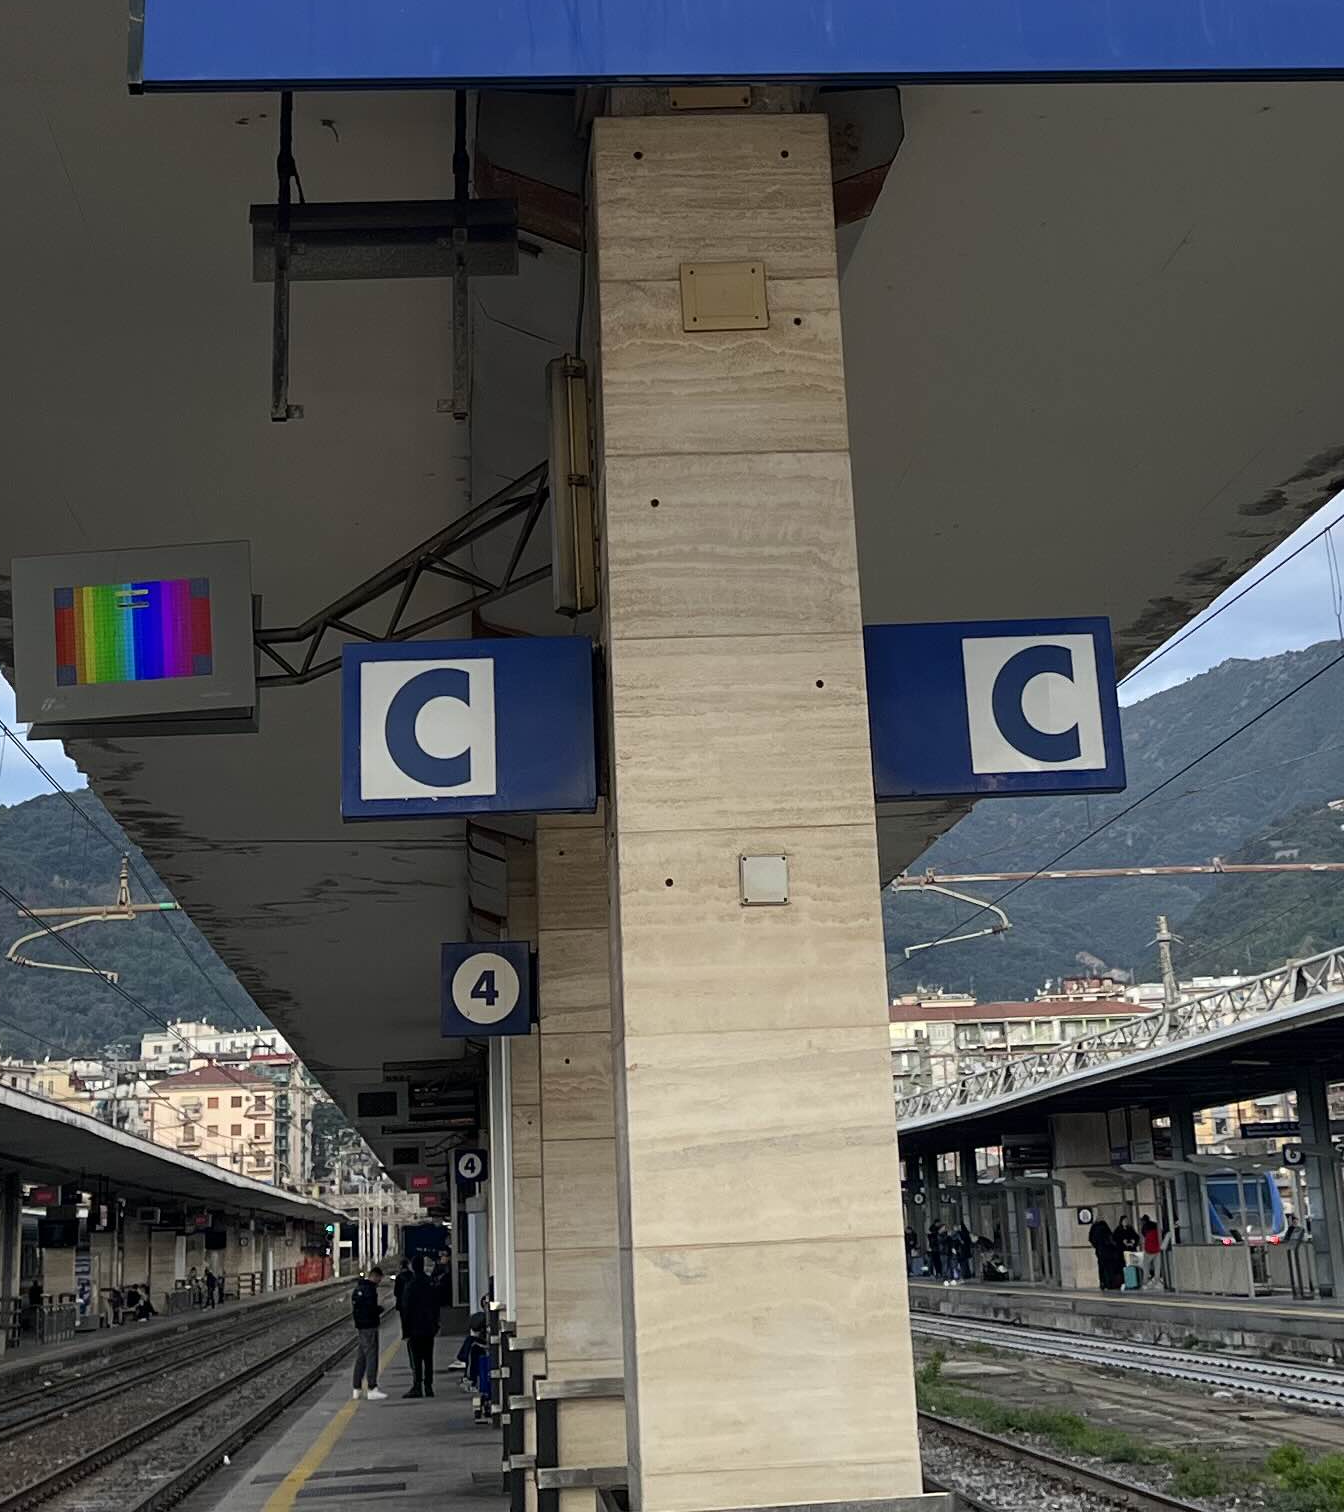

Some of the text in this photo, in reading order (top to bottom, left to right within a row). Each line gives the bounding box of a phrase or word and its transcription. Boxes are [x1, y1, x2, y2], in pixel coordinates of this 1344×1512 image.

[384, 667, 472, 788] C
[992, 644, 1082, 763] C
[470, 968, 500, 1007] 4
[463, 1157, 477, 1174] 4
